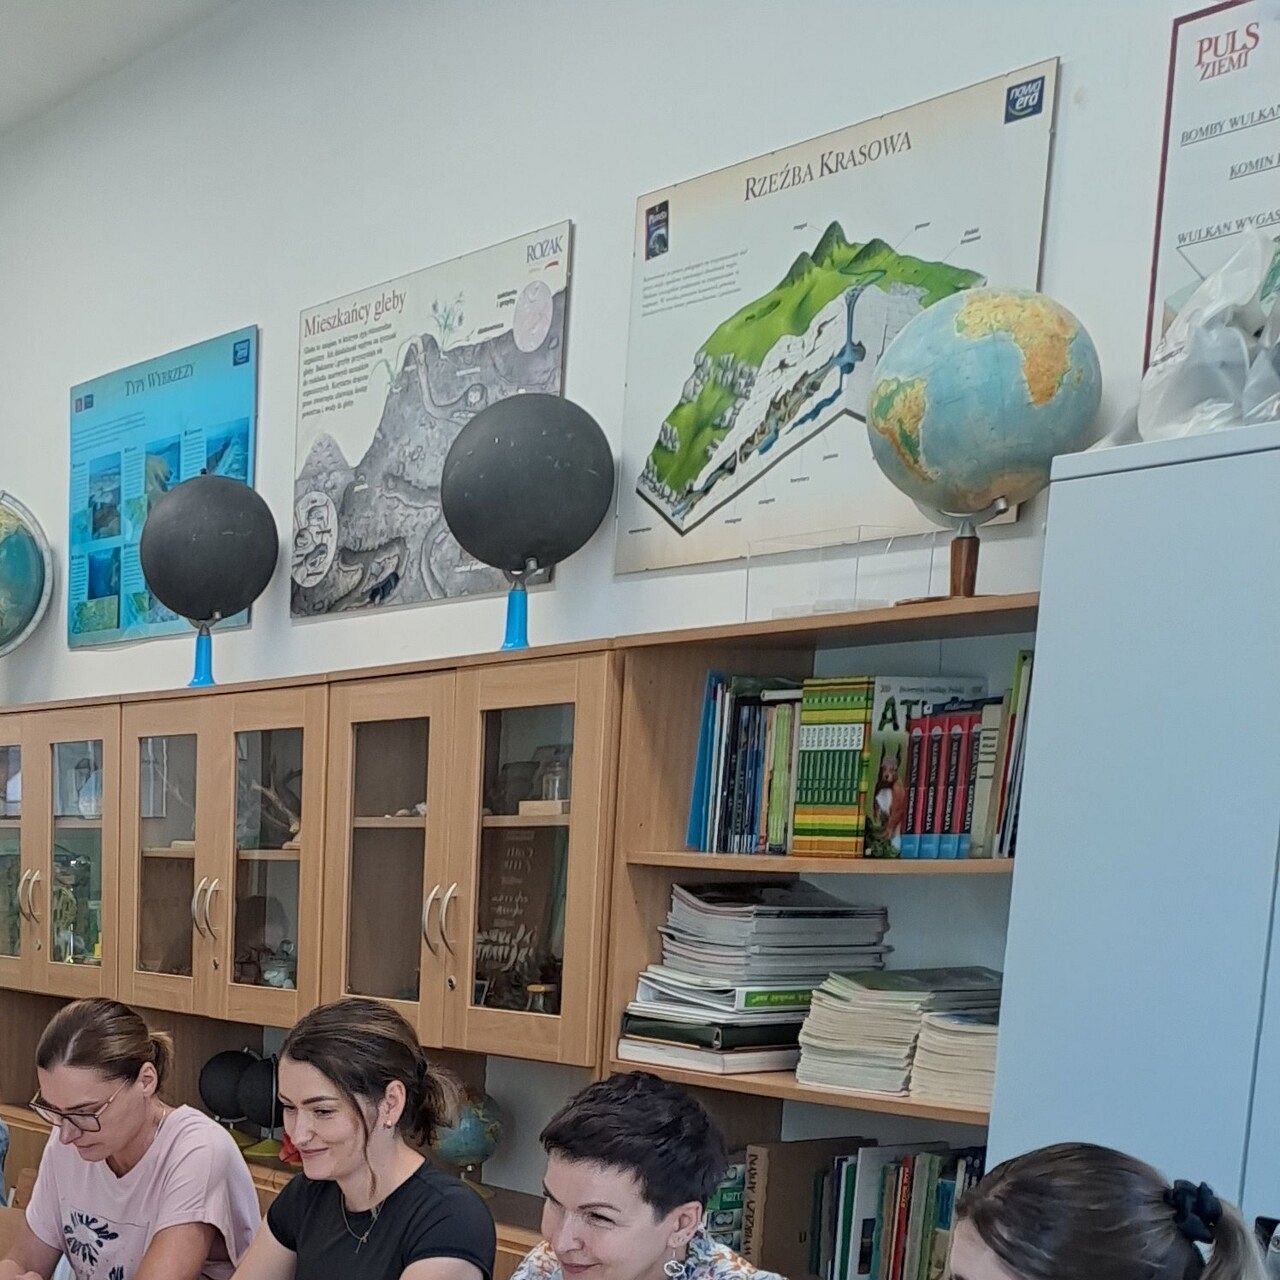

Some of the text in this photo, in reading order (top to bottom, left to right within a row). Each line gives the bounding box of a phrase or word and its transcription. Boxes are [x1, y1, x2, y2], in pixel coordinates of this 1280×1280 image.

[1195, 22, 1260, 67] PULS
[1199, 49, 1249, 81] ZIEMI
[1010, 79, 1041, 100] nowa
[1015, 93, 1039, 110] era
[1181, 120, 1225, 143] BOMBY
[744, 131, 912, 201] RZEŹBA KRASOWA
[1230, 154, 1275, 178] KOMIN
[1177, 221, 1232, 245] WULKAN
[304, 289, 407, 338] Mieszkańcy gleby
